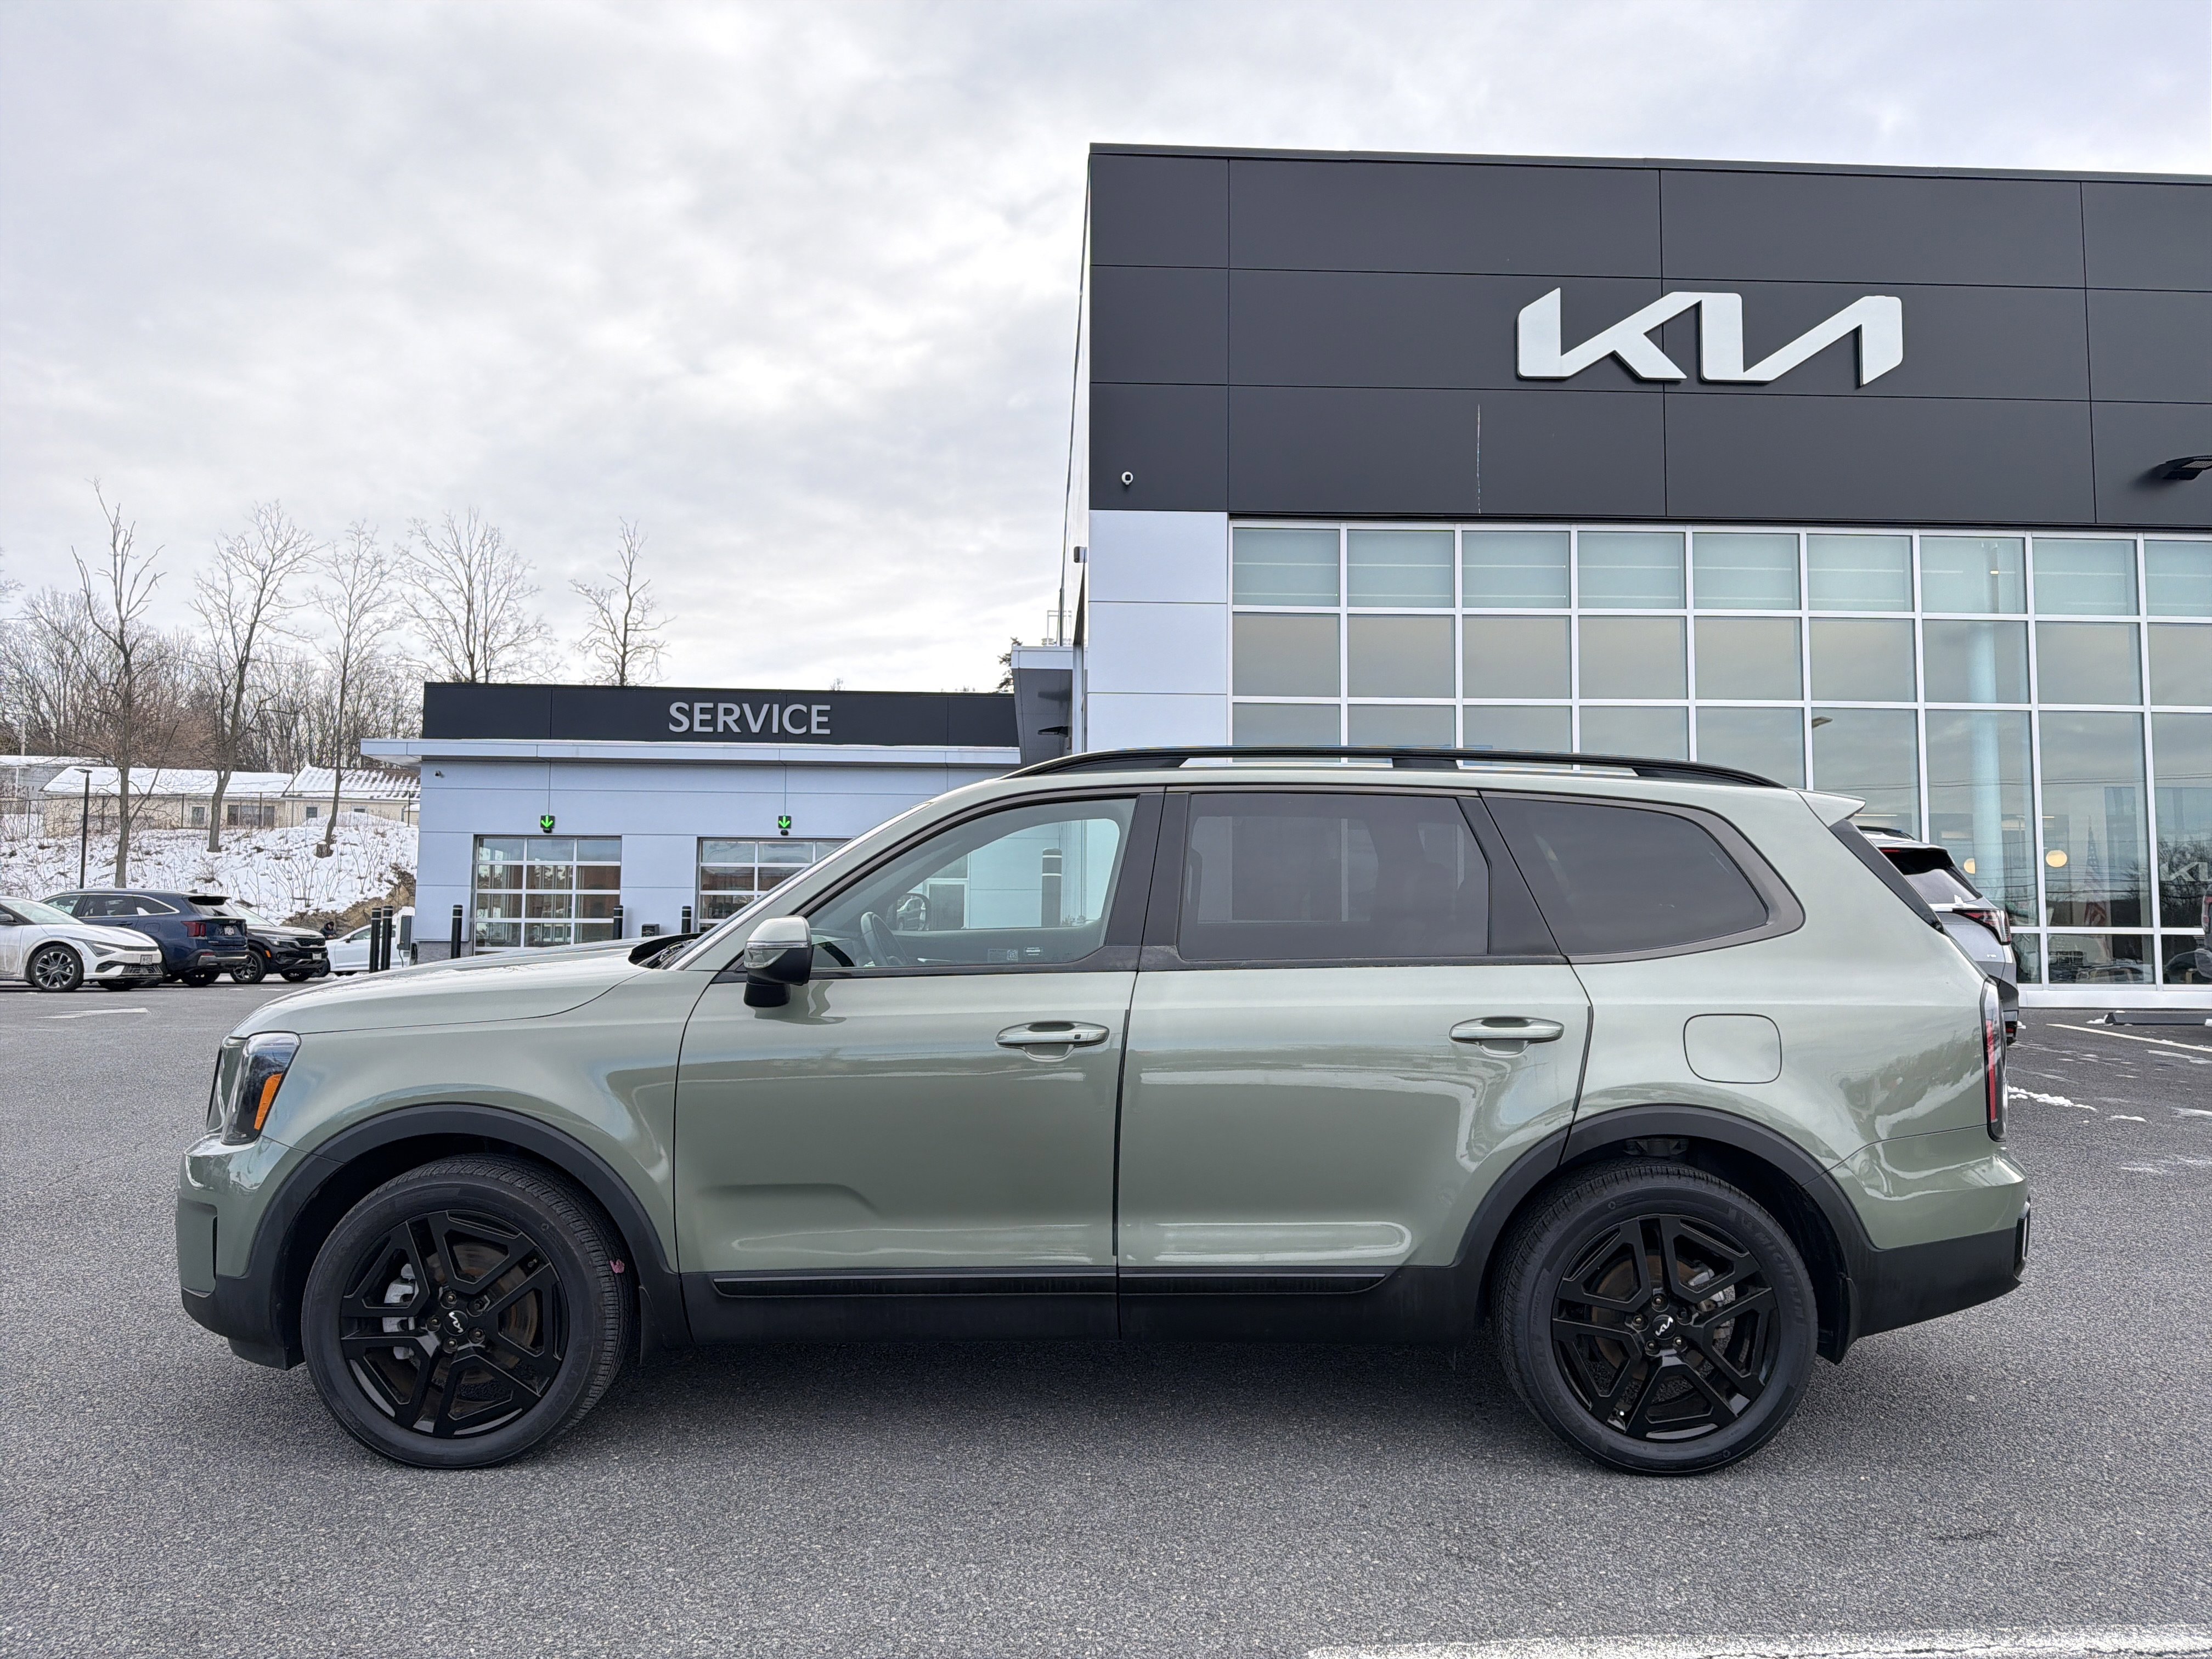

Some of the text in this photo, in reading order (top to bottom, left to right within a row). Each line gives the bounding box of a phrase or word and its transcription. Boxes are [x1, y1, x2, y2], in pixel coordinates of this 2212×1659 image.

[1517, 287, 1904, 386] KIA
[669, 701, 831, 735] SERVICE
[2159, 861, 2212, 882] KI
